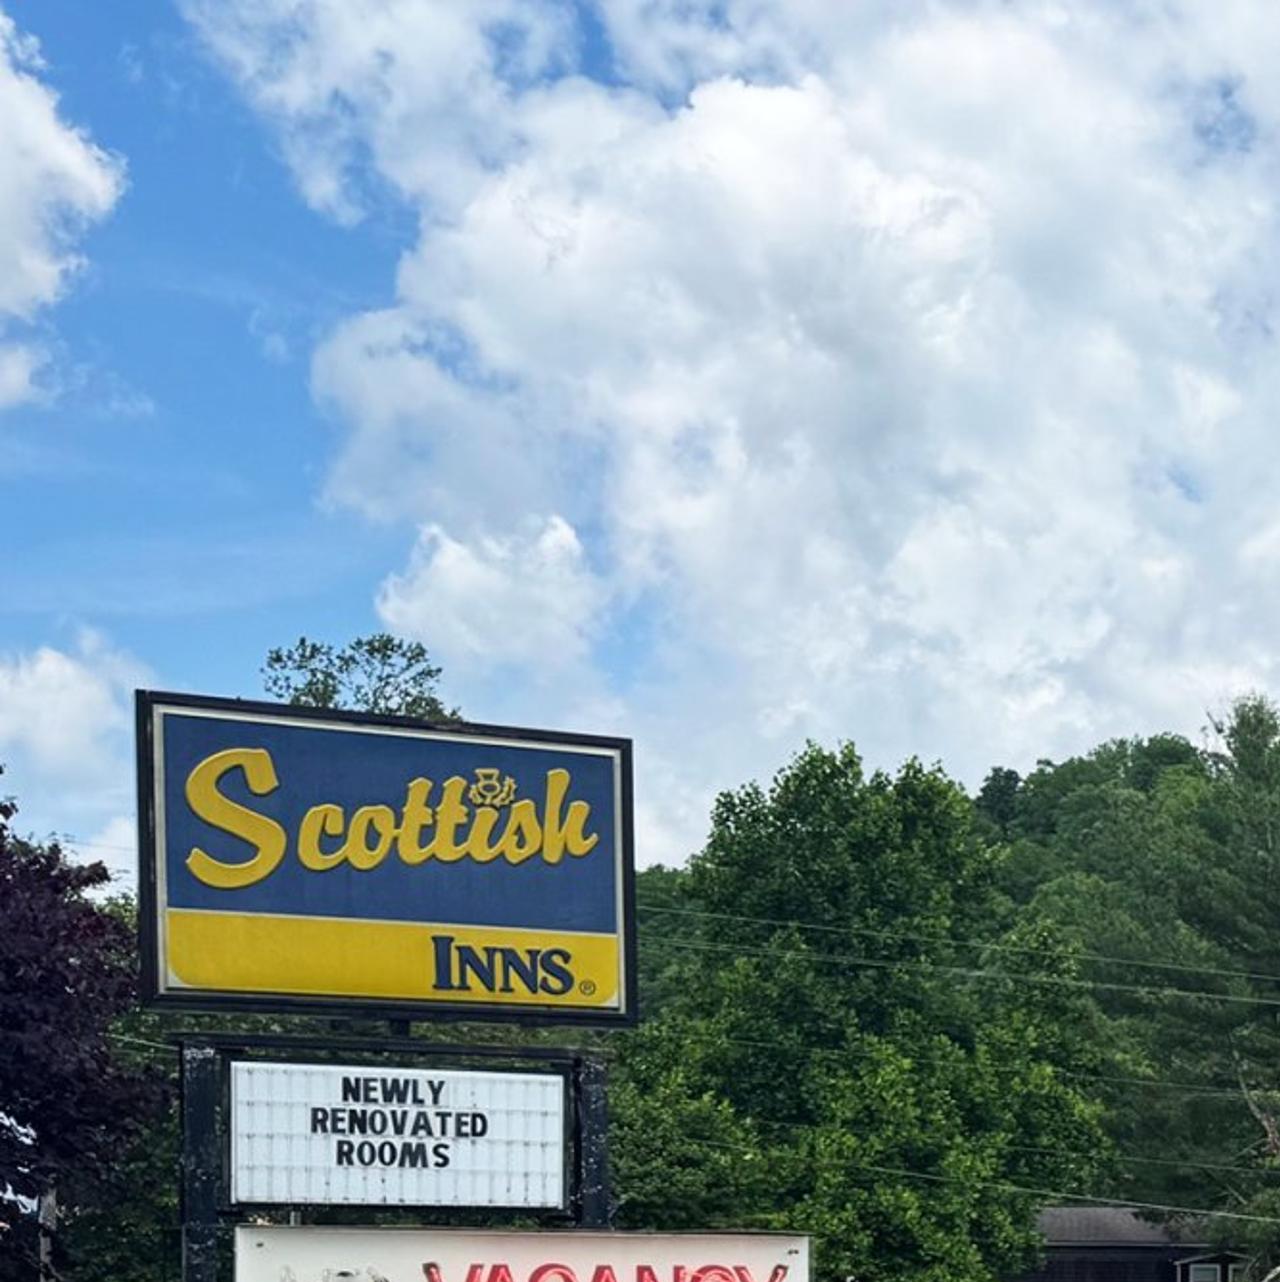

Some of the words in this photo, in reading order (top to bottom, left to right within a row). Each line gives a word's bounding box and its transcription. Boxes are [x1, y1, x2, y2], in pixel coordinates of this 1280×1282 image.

[184, 747, 600, 890] Scottish
[341, 1076, 446, 1104] NEWLY
[310, 1107, 489, 1138] RENOVATED
[335, 1140, 451, 1168] ROOMS
